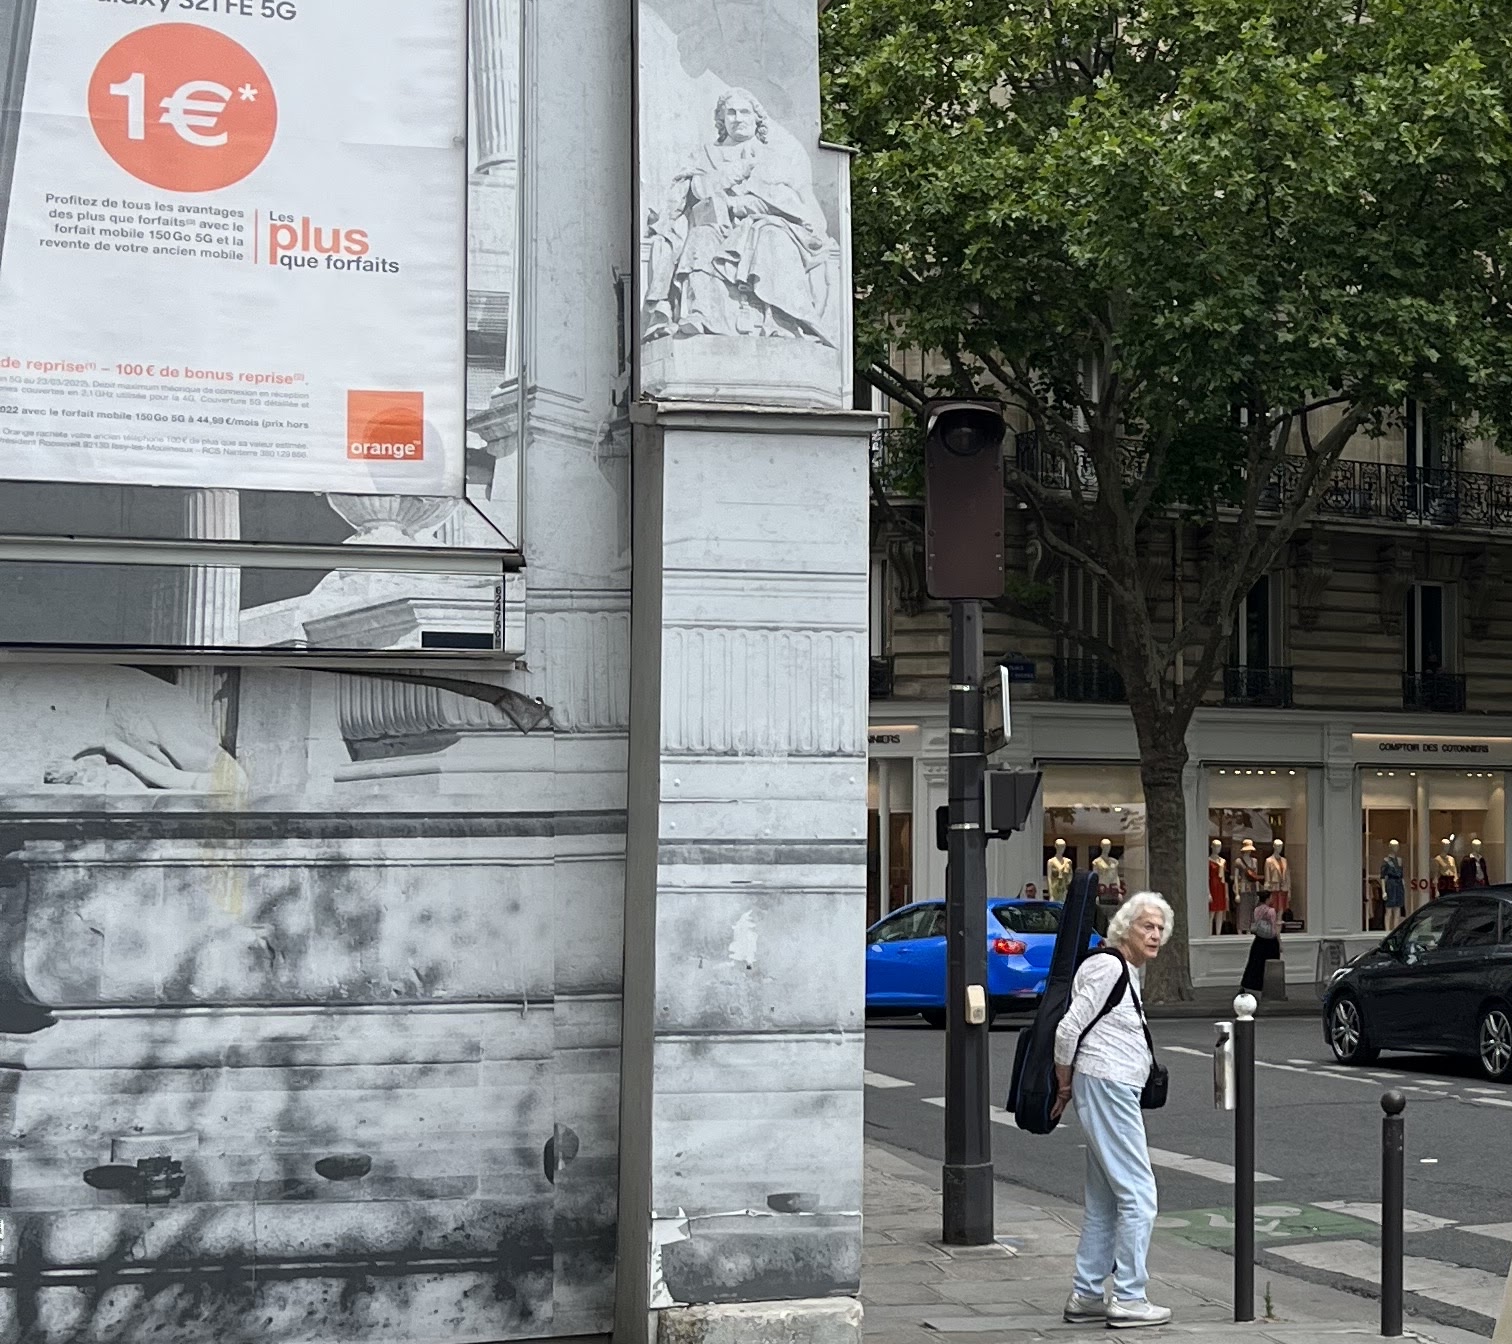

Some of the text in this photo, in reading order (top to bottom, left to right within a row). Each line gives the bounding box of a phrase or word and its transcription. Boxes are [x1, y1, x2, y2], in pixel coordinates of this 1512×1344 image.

[45, 193, 244, 220] Profitez de tous les avantages
[269, 210, 294, 223] Les
[49, 208, 73, 220] des
[77, 210, 106, 223] plus
[109, 214, 134, 226] que
[199, 220, 229, 232] avec
[232, 220, 244, 233] le
[54, 222, 95, 236] forfait
[99, 225, 144, 239] mobile
[194, 232, 213, 244] 5G
[216, 234, 229, 246] et
[232, 235, 244, 247] la
[269, 216, 370, 265] plus
[39, 238, 244, 261] revente de votre ancien mobile
[280, 254, 400, 273] que forfaits
[0, 356, 21, 368] de
[160, 365, 180, 377] de
[185, 366, 234, 381] bonus
[149, 393, 168, 402] pour
[200, 395, 247, 405] Couverture
[22, 408, 46, 416] avec
[49, 408, 59, 417] le
[62, 409, 94, 418] forfait
[96, 411, 132, 421] mobile
[171, 414, 185, 423] 5G
[262, 418, 284, 429] (prix
[286, 420, 310, 429] hors
[2, 427, 34, 438] Orange
[1379, 742, 1489, 753] COMPTOIR DES COTONNIERS
